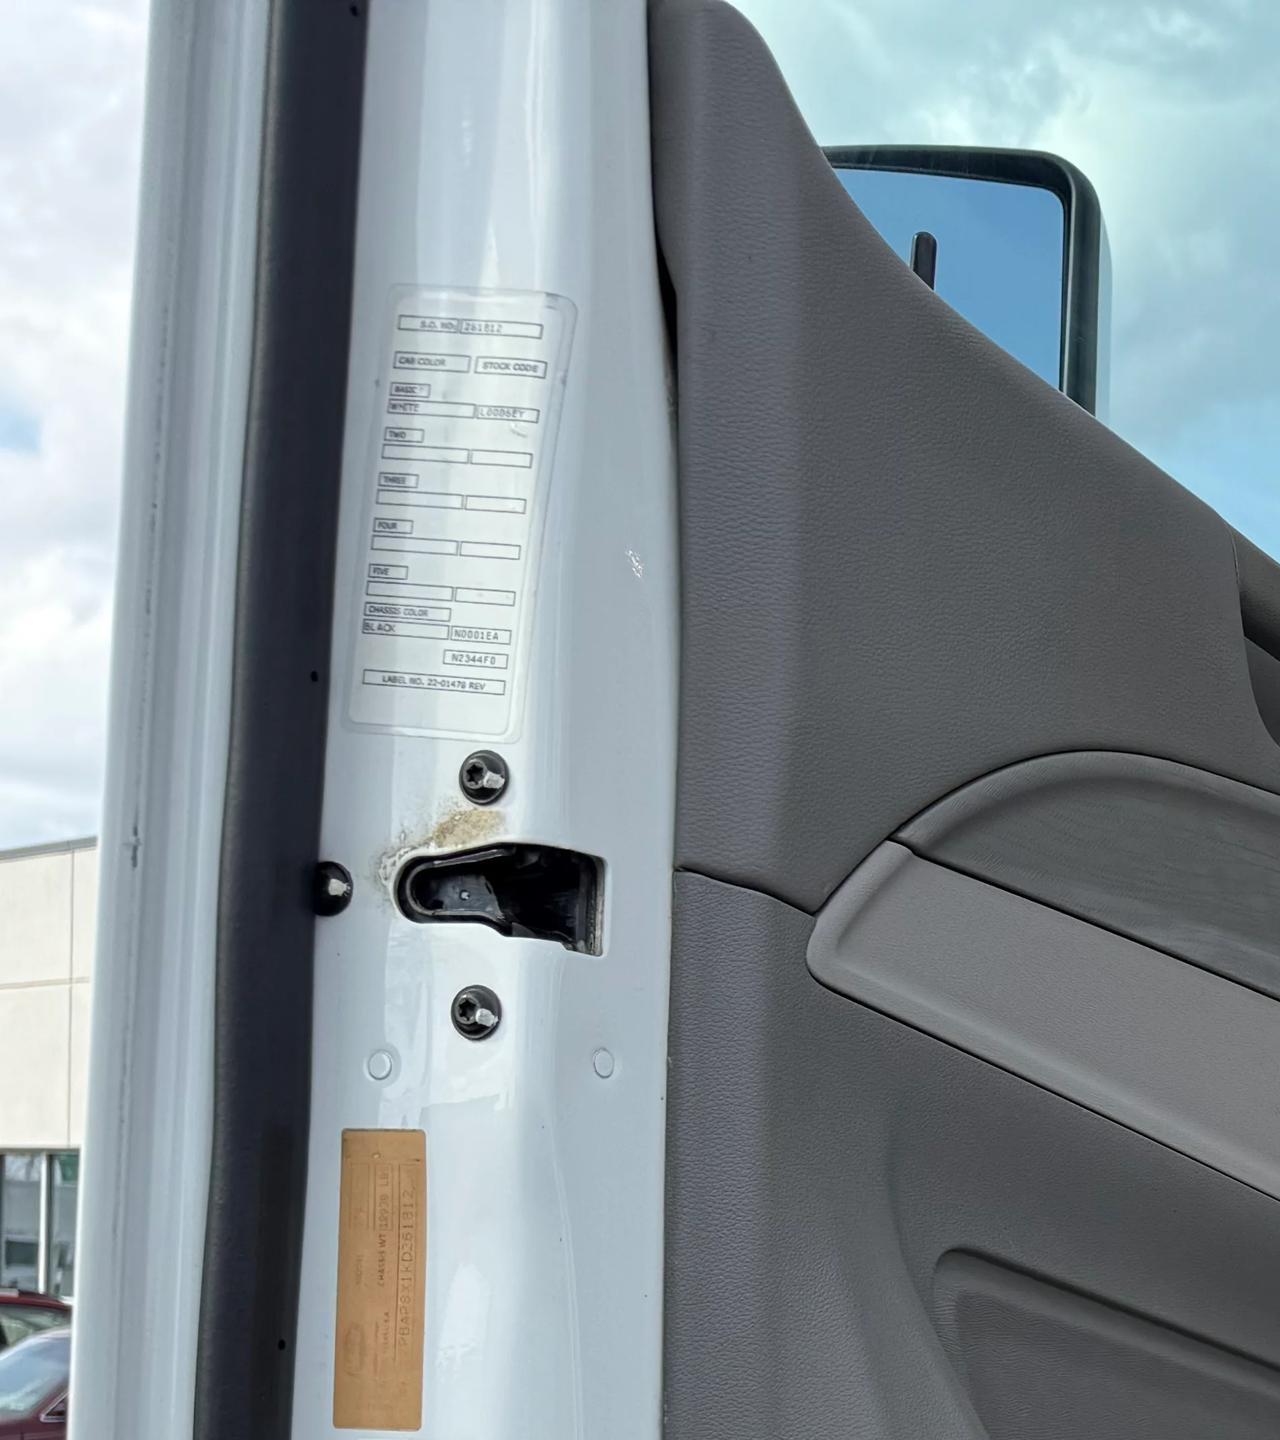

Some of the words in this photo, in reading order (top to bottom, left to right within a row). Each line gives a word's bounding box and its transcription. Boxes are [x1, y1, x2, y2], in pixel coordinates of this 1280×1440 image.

[416, 357, 446, 367] COLOR
[482, 361, 510, 371] STOCK
[513, 363, 539, 373] CODE
[389, 403, 419, 413] WHITE
[388, 430, 407, 439] TWO
[383, 476, 406, 485] THREE
[377, 521, 398, 530] FOUR
[373, 567, 390, 576] FIVE
[368, 605, 401, 615] CHASSIS
[403, 608, 429, 617] COLOR
[363, 622, 396, 633] BLACK
[382, 675, 407, 684] LABEL
[468, 681, 486, 691] REV
